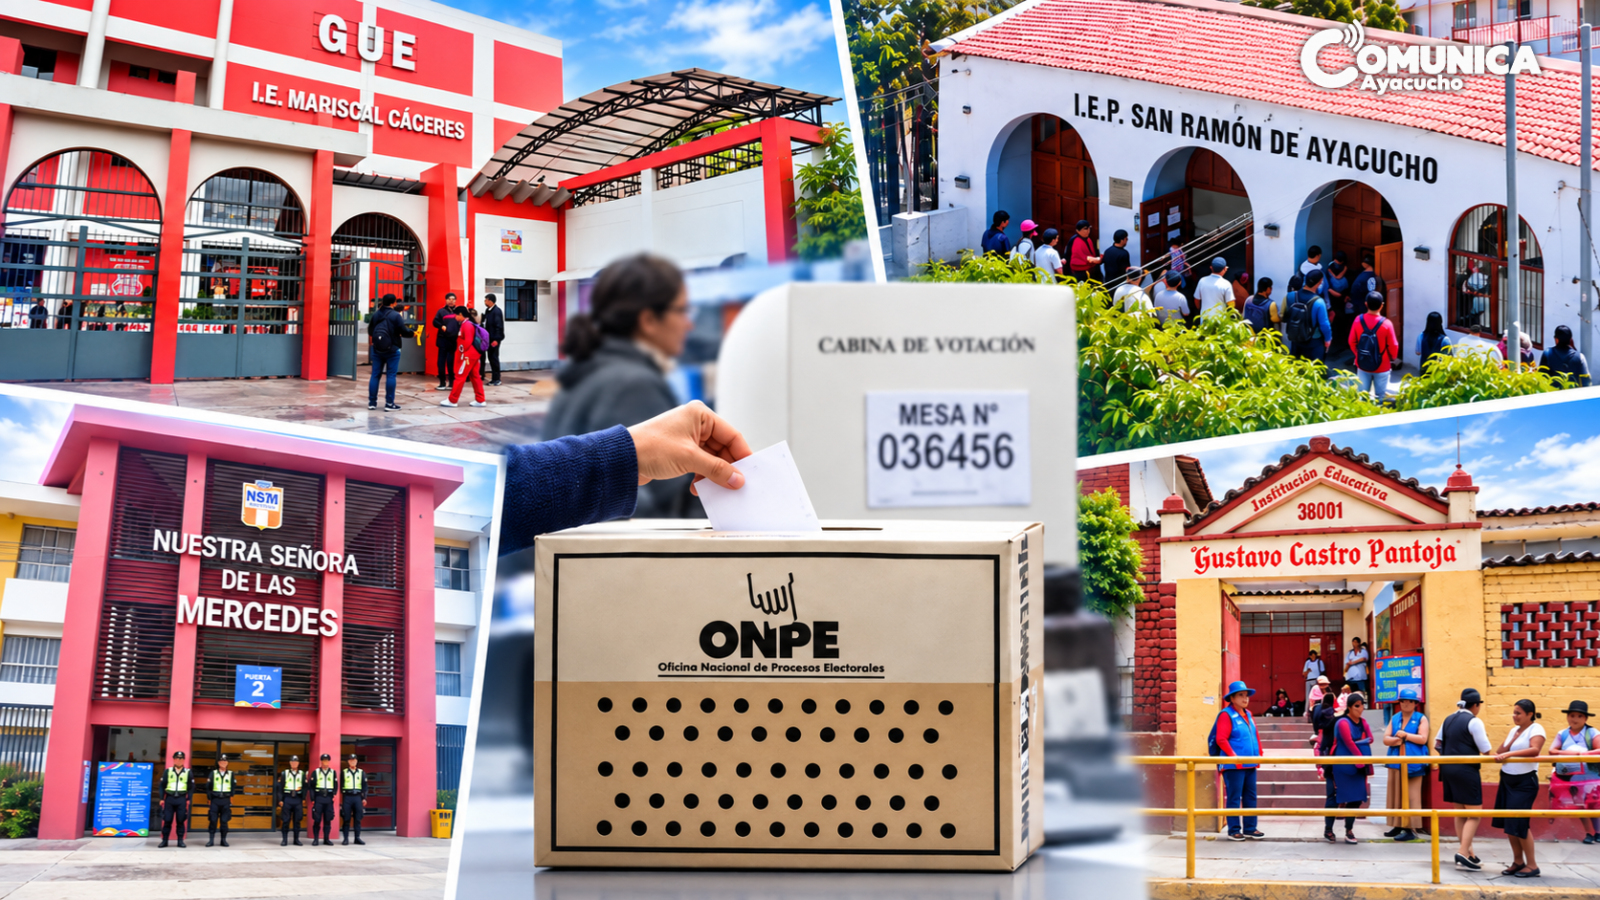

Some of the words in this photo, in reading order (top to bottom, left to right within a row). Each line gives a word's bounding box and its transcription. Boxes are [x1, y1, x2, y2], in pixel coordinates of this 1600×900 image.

[318, 14, 417, 71] GUE
[251, 81, 283, 107] I.E.
[287, 88, 385, 126] MARISCAL
[387, 107, 466, 140] CÁCERES
[1074, 93, 1124, 125] I.E.P.
[1131, 103, 1173, 134] SAN
[1181, 112, 1263, 151] RAMÓN
[1270, 129, 1299, 158] DE
[1305, 136, 1438, 184] AYACUCHO
[818, 337, 896, 354] CABINA
[903, 338, 929, 353] DE
[935, 333, 1036, 353] VOTACIÓN
[899, 403, 966, 426] MESA
[878, 432, 1015, 471] 036456
[1324, 465, 1388, 501] Educativa
[1297, 501, 1343, 521] 38001
[153, 529, 263, 563] NUESTRA
[270, 544, 360, 575] SEÑORA
[1289, 541, 1361, 567] Castro
[222, 569, 250, 591] DE
[255, 572, 296, 596] LAS
[177, 594, 339, 637] MERCEDES
[699, 620, 840, 659] ONPE
[658, 662, 698, 672] Oficina
[701, 662, 751, 673] Nacional
[754, 662, 768, 673] de
[771, 663, 821, 673] Procesos
[824, 663, 885, 673] Electorales
[251, 680, 265, 697] 2
